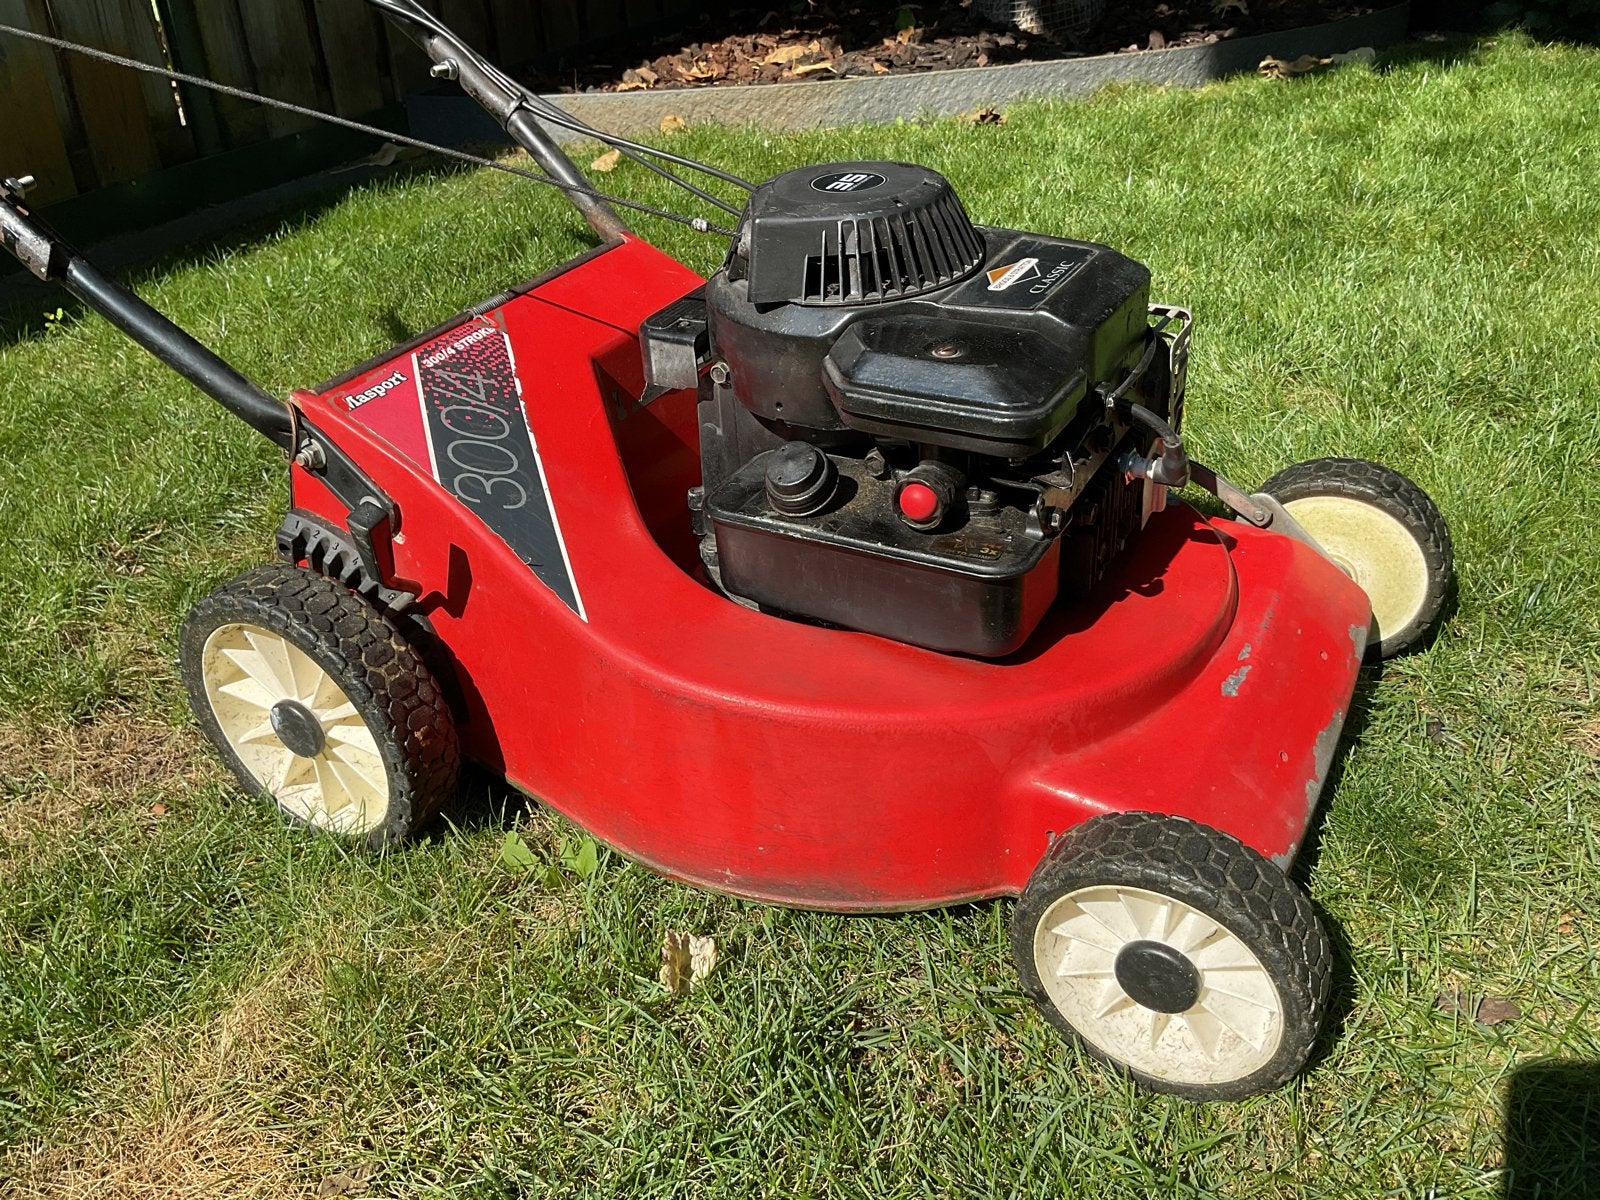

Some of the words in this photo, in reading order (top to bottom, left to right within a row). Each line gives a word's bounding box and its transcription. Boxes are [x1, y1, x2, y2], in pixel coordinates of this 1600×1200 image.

[825, 173, 868, 191] 35
[1029, 260, 1075, 294] CLASSIC
[422, 346, 456, 368] 300/4
[454, 327, 496, 351] STROKE
[431, 368, 527, 510] 300/4
[312, 529, 320, 539] 2
[332, 542, 340, 551] 3
